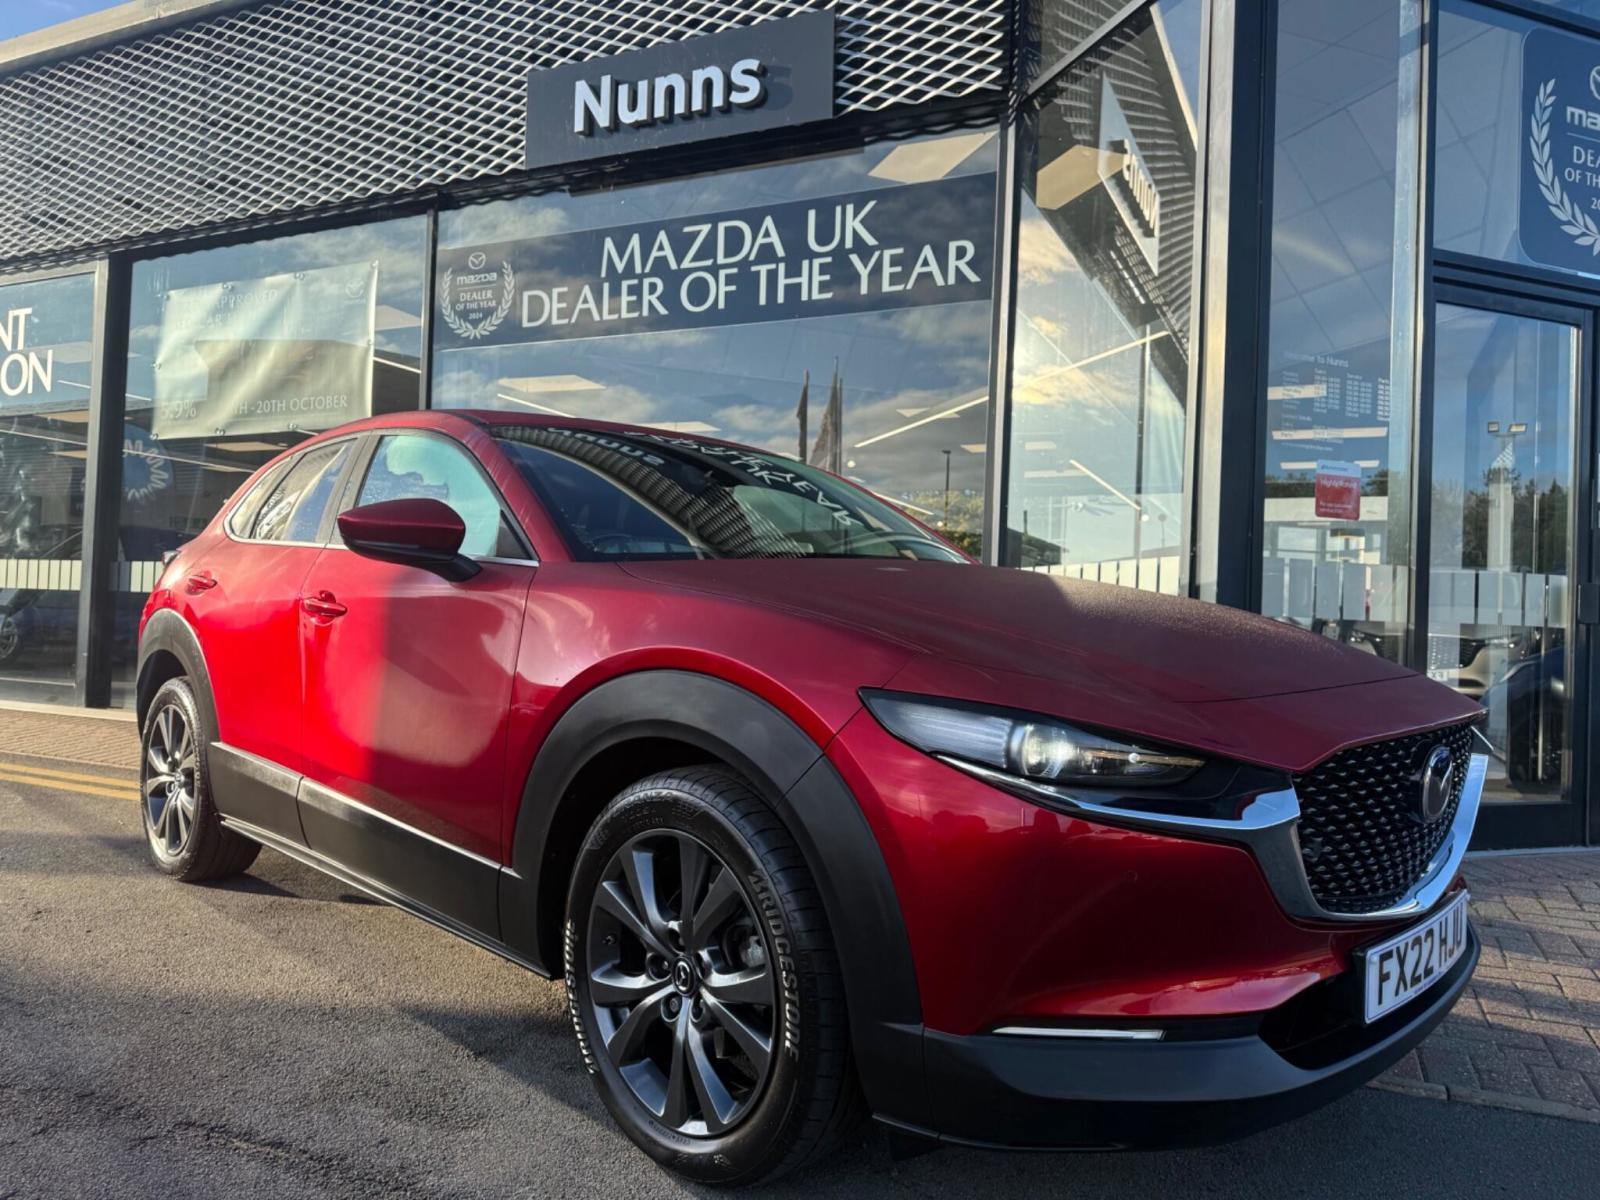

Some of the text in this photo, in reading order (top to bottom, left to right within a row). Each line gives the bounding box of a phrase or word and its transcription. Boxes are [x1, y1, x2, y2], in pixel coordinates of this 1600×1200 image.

[574, 58, 765, 134] Nunns
[1564, 167, 1582, 184] OF
[601, 200, 879, 278] MAZDA UK
[456, 272, 498, 286] mazda
[460, 289, 493, 302] DEALER
[521, 239, 981, 328] DEALER OF THE YEAR
[456, 300, 496, 311] OF THE YEAR
[0, 307, 33, 352] NT
[0, 349, 53, 396] ON
[289, 394, 348, 412] OCTOBER
[1378, 927, 1434, 1006] FX22
